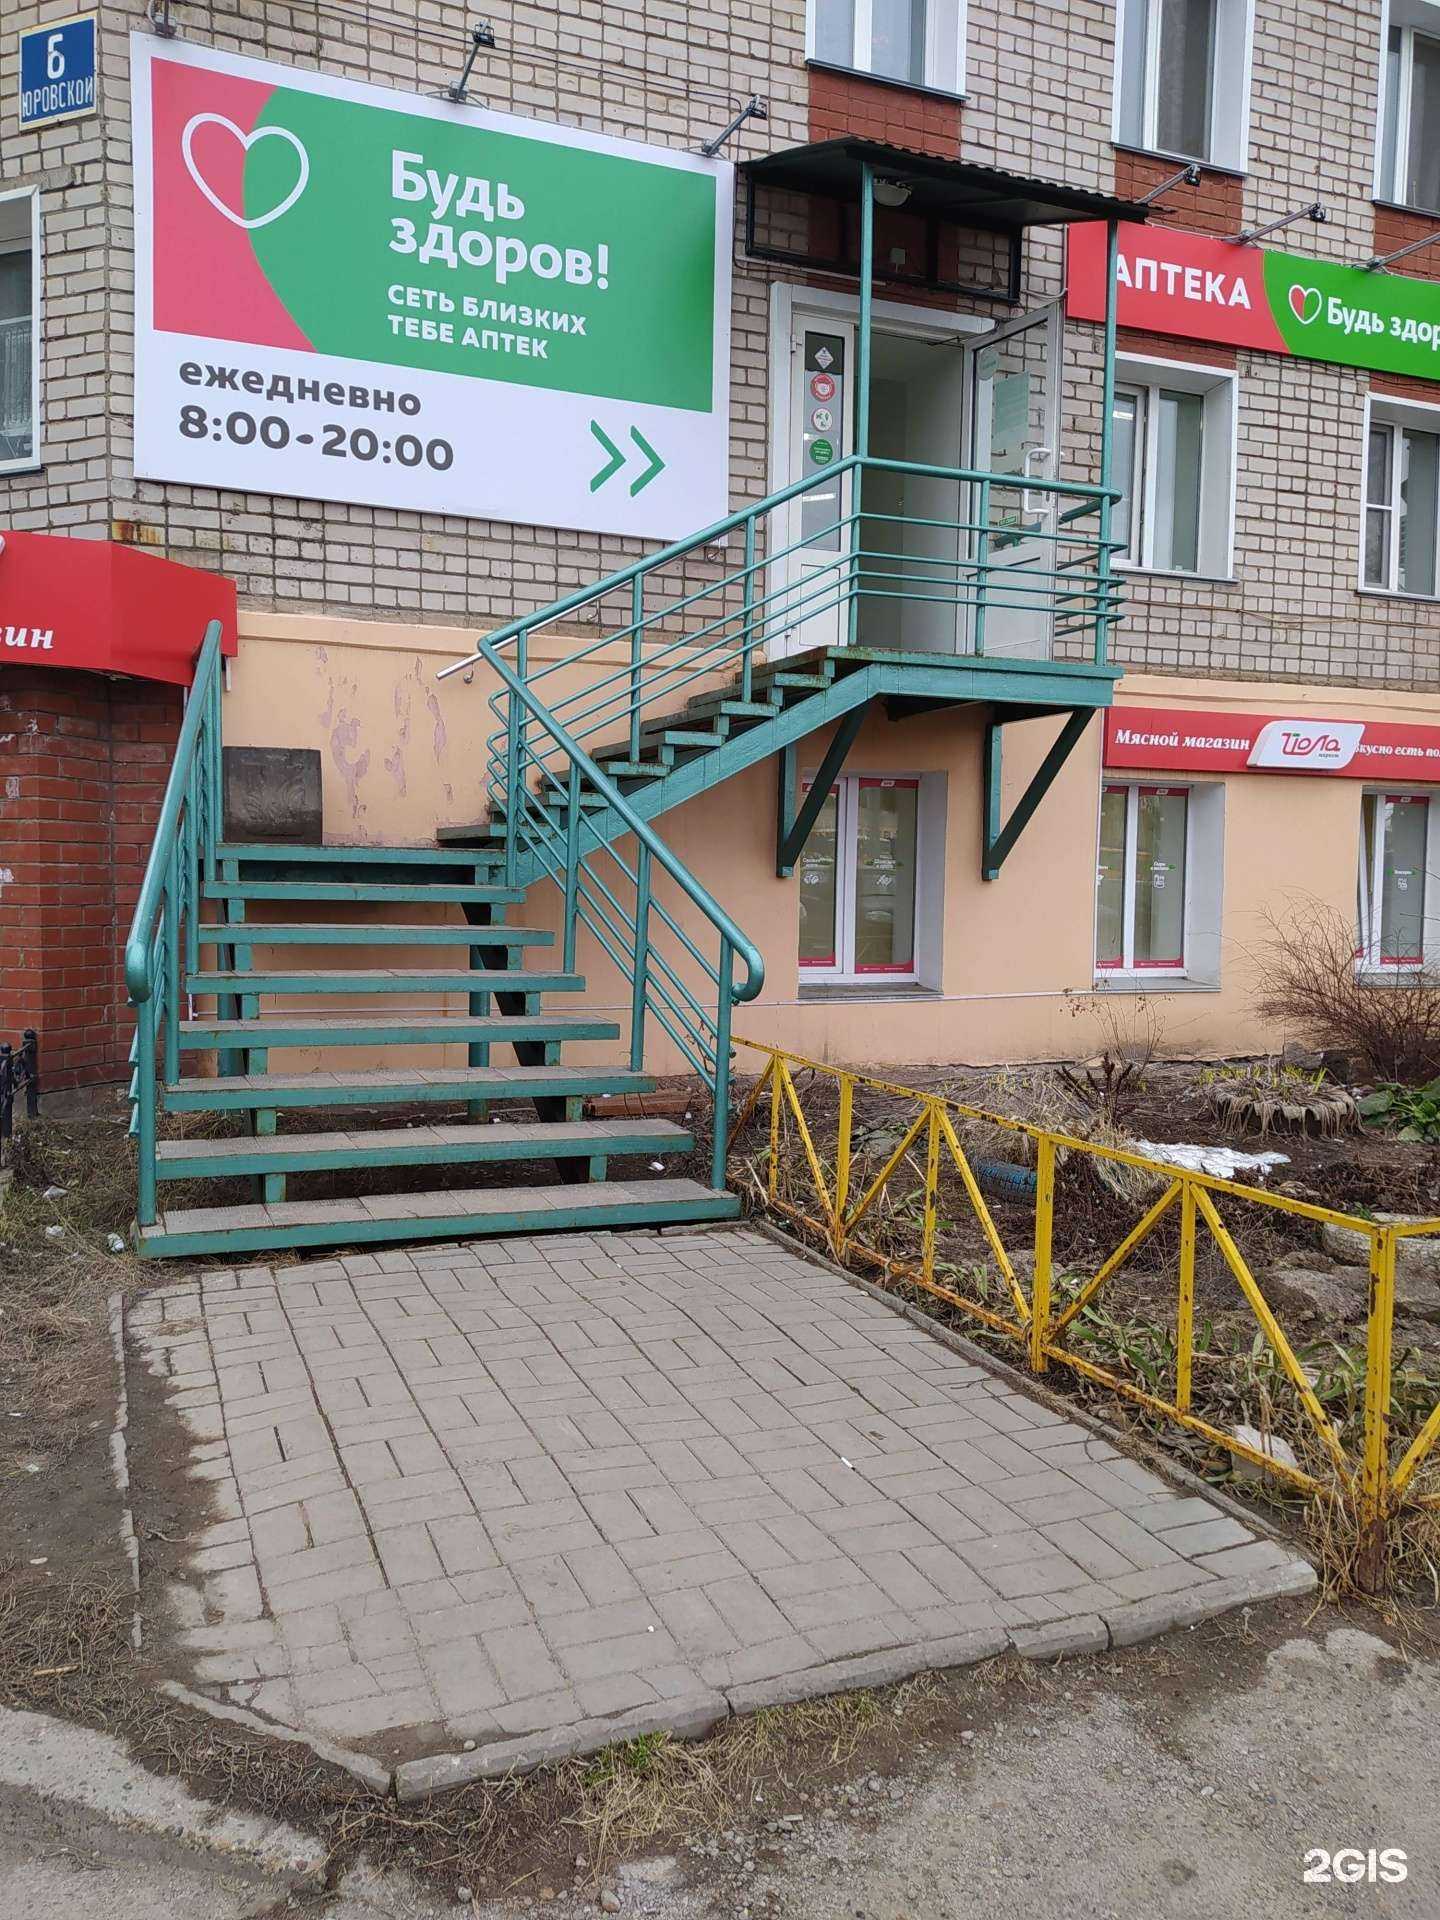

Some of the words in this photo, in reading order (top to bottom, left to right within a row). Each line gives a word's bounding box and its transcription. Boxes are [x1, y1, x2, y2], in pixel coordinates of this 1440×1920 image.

[47, 33, 65, 79] 6
[22, 76, 93, 117] ЮРОВСКОЙ
[392, 150, 525, 222] Будь
[389, 218, 609, 290] здоров!
[1116, 253, 1252, 310] АПТЕКА
[388, 285, 455, 313] СЕТЬ
[463, 296, 586, 336] БЛИЗКИХ
[1327, 296, 1385, 335] Будь
[388, 314, 454, 344] ТЕБЕ
[461, 327, 548, 359] АПТЕК
[179, 361, 421, 416] ежедневно
[179, 405, 454, 471] 8:00-20:00
[1115, 729, 1179, 747] Мясной
[1182, 735, 1250, 750] магазин
[1394, 746, 1424, 755] есть
[1426, 748, 1440, 758] по
